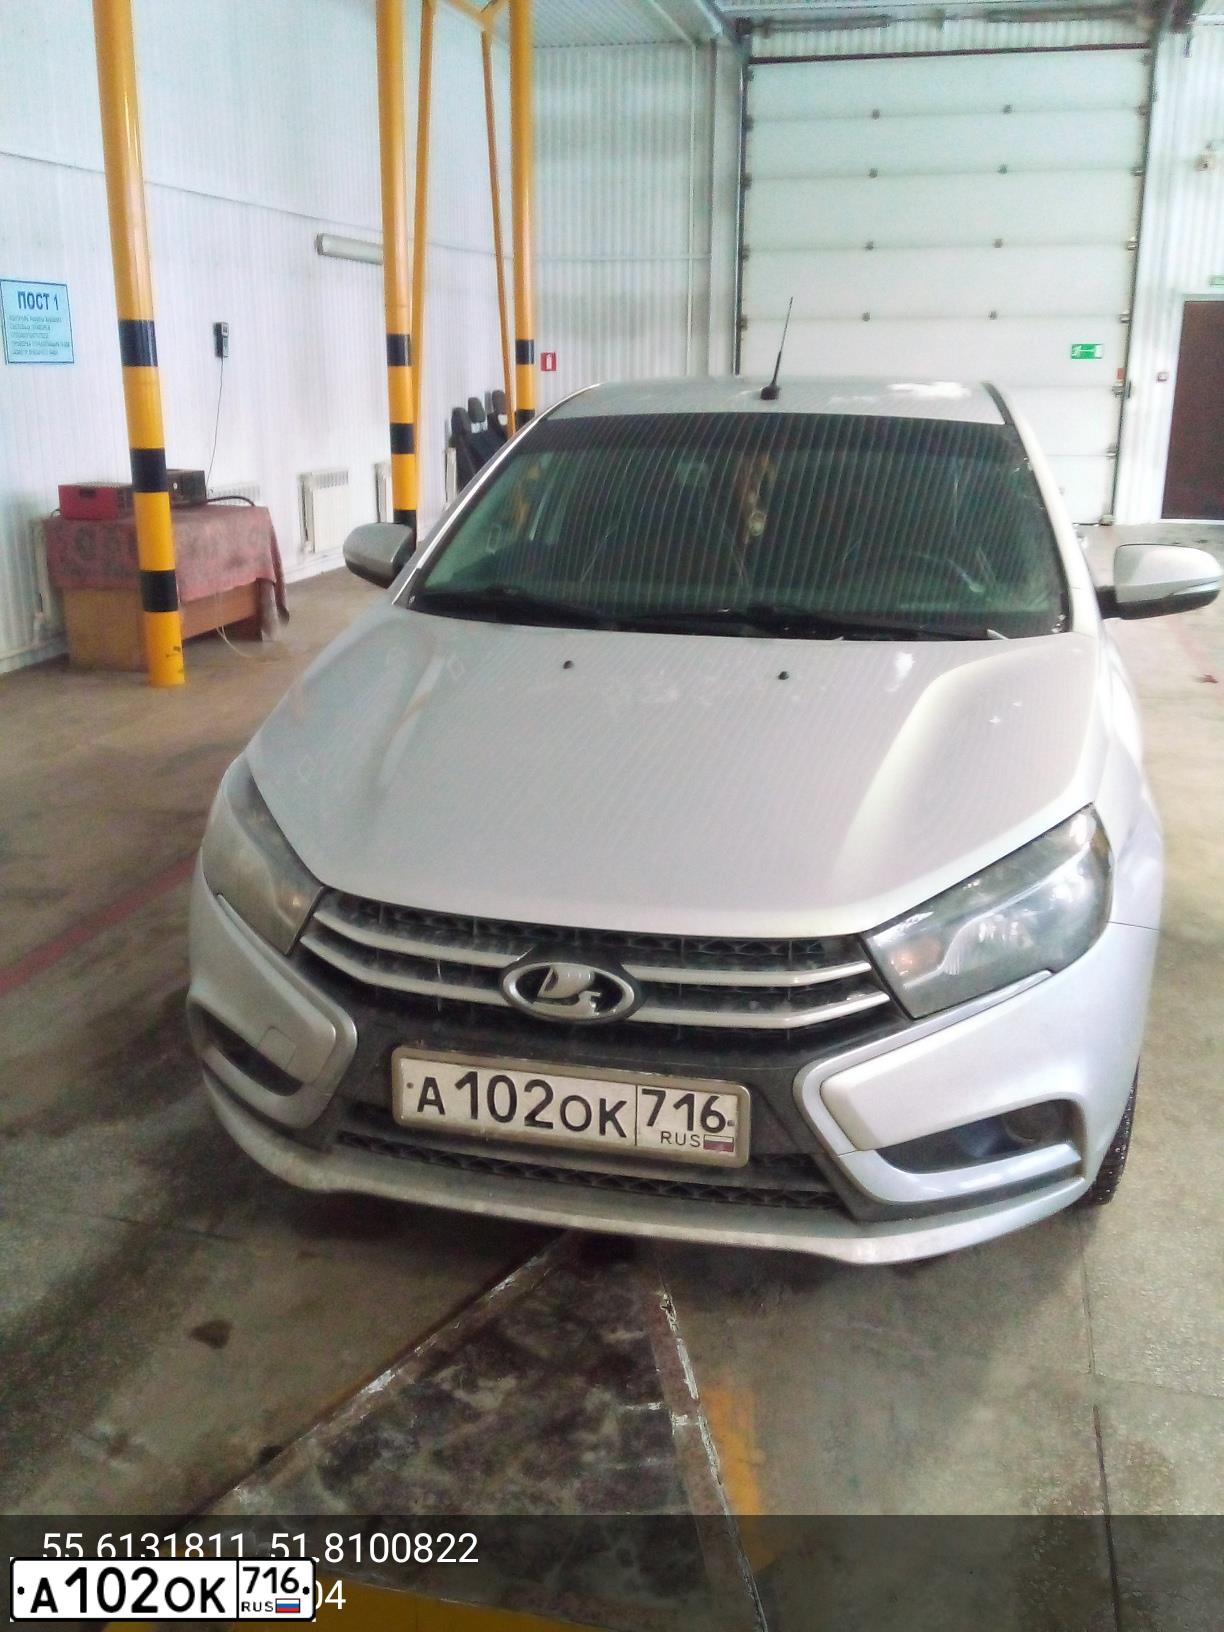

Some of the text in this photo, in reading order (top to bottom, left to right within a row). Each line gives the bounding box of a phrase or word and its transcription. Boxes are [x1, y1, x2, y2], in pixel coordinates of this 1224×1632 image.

[17, 291, 59, 310] ПОСТ 1
[642, 1089, 727, 1133] 716
[660, 1131, 701, 1149] RUS
